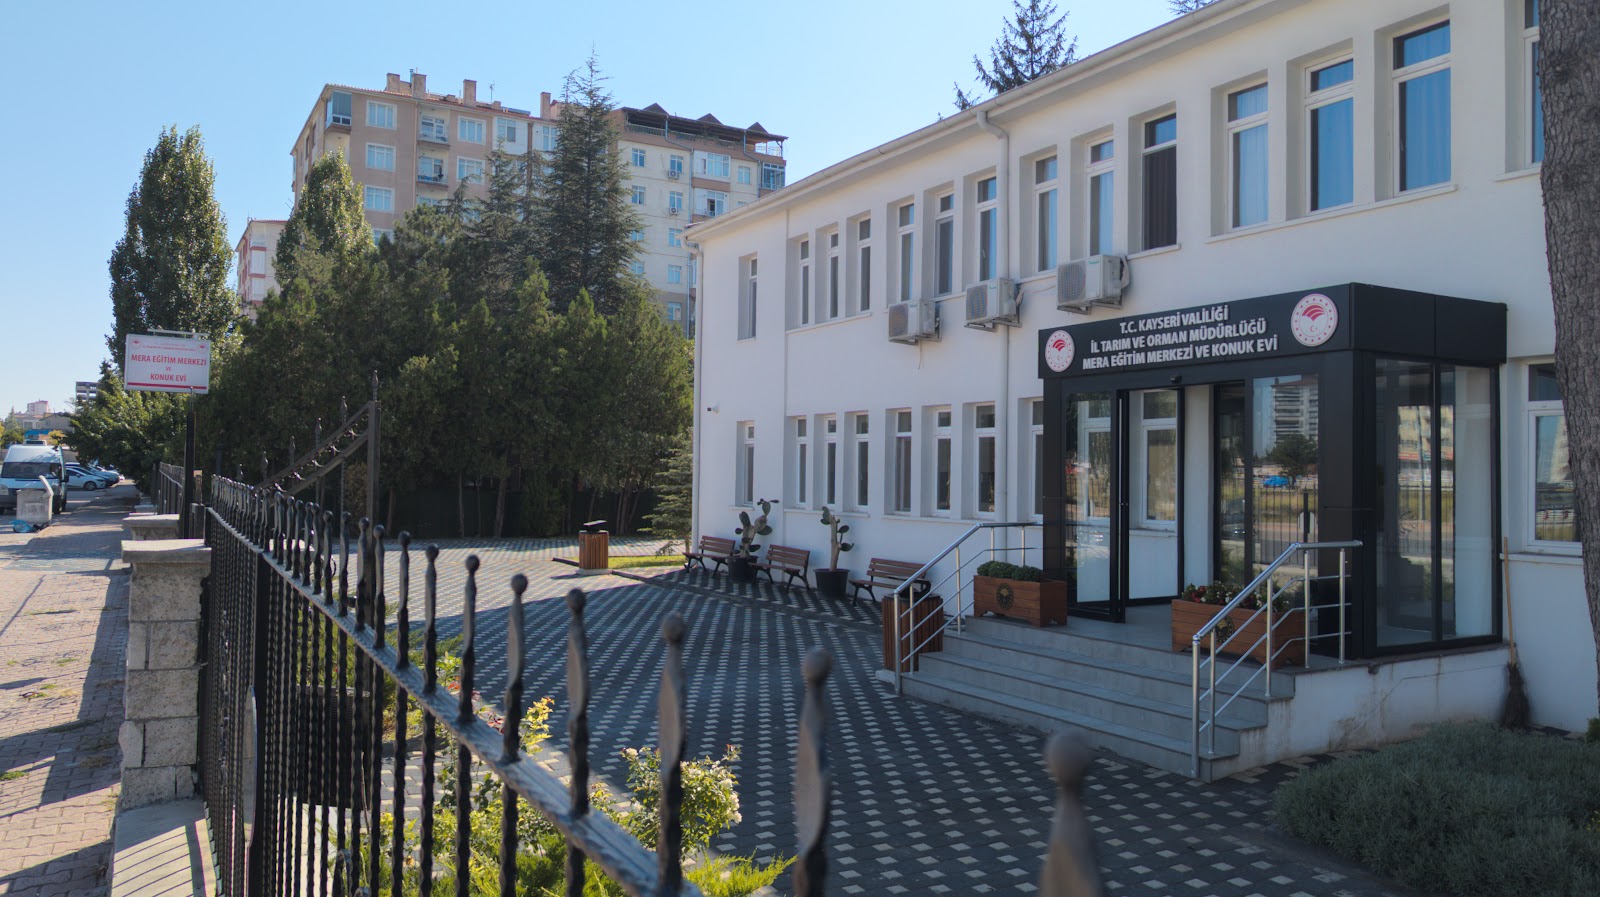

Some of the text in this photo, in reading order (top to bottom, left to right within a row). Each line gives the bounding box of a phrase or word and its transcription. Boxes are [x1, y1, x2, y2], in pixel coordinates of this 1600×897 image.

[1120, 305, 1229, 334] T.C. KAYSERİ VALİLİĞİ
[1090, 317, 1267, 354] İL TARIM VE ORMAN MÜDÜRLÜĞÜ
[131, 354, 206, 365] MERA EĞİTİM MERKEZİ
[1082, 334, 1279, 370] MERA EĞİTİM MERKEZİ VE KONUK EVİ
[150, 373, 174, 381] KONUK
